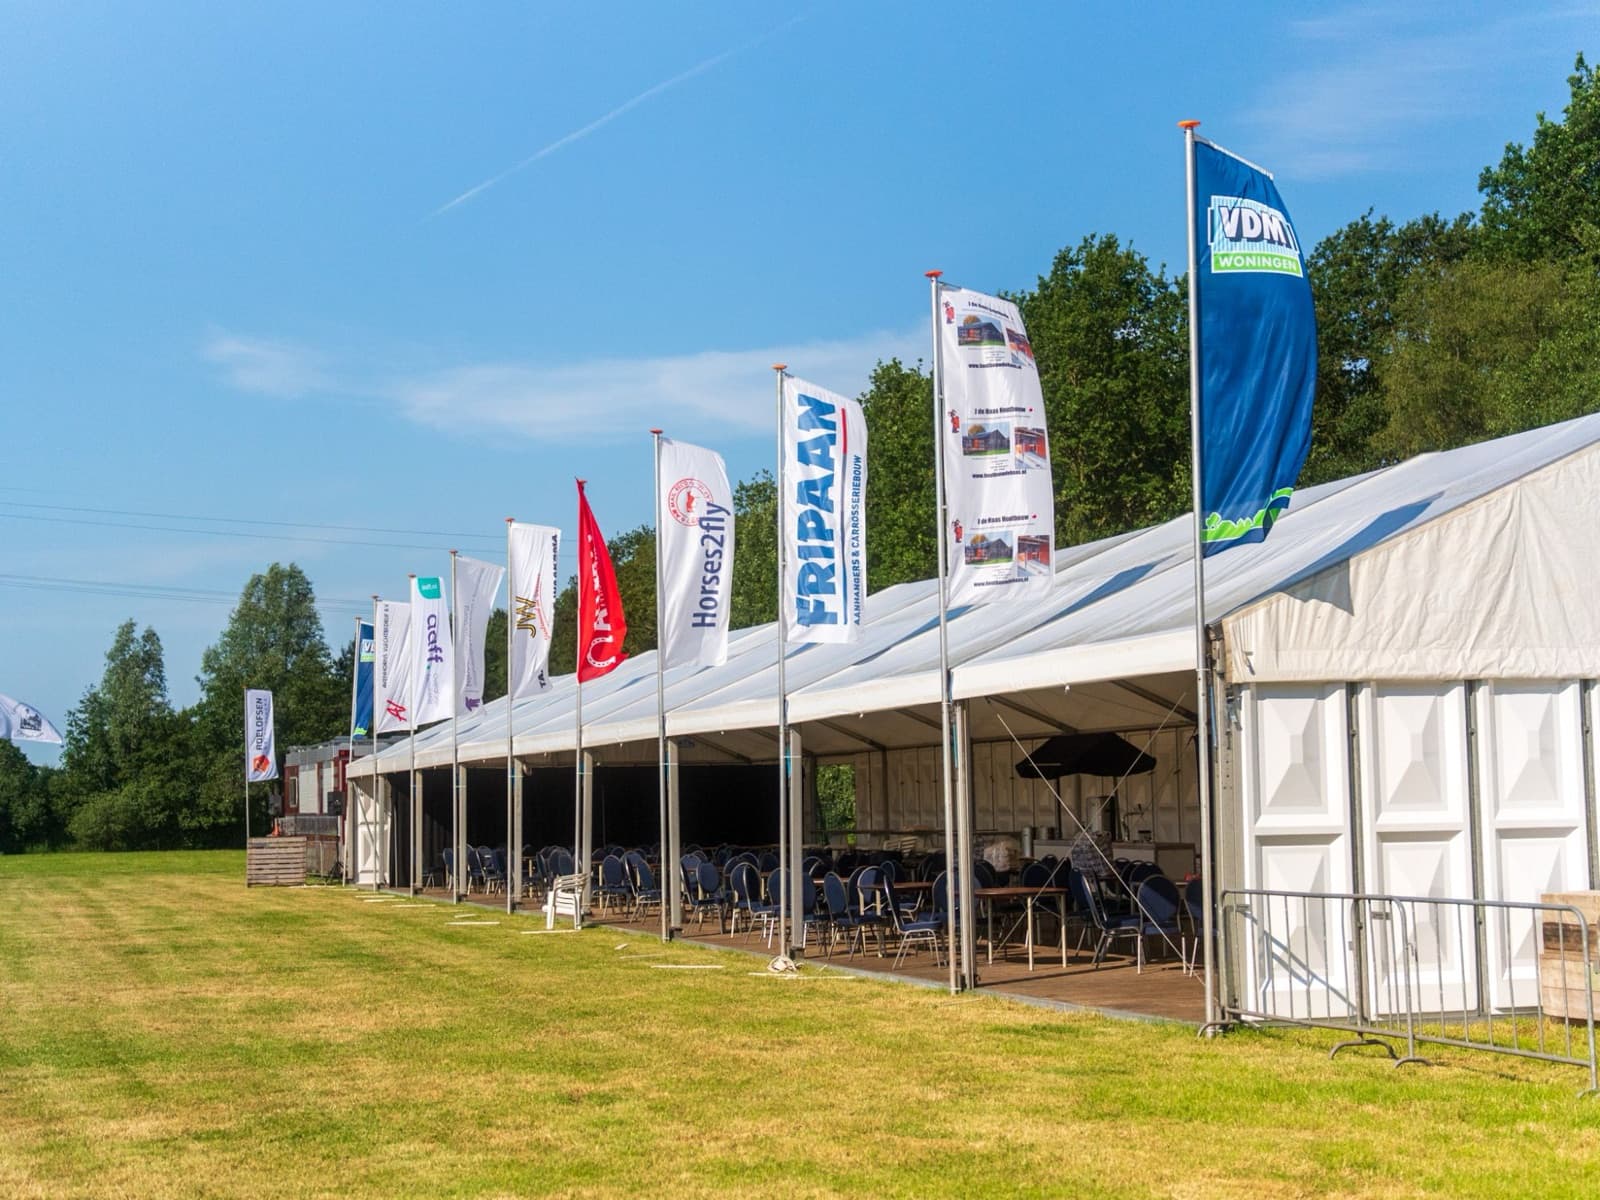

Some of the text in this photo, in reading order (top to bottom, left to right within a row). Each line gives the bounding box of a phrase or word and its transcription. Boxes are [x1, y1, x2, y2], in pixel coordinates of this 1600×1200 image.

[1218, 206, 1291, 247] VDM
[1218, 255, 1297, 271] WONINGEN
[796, 394, 837, 627] FRIPAAN
[851, 455, 862, 548] CARROSSERIEBOUW
[691, 502, 731, 628] Horses2fly
[852, 559, 861, 625] AANHANGERS
